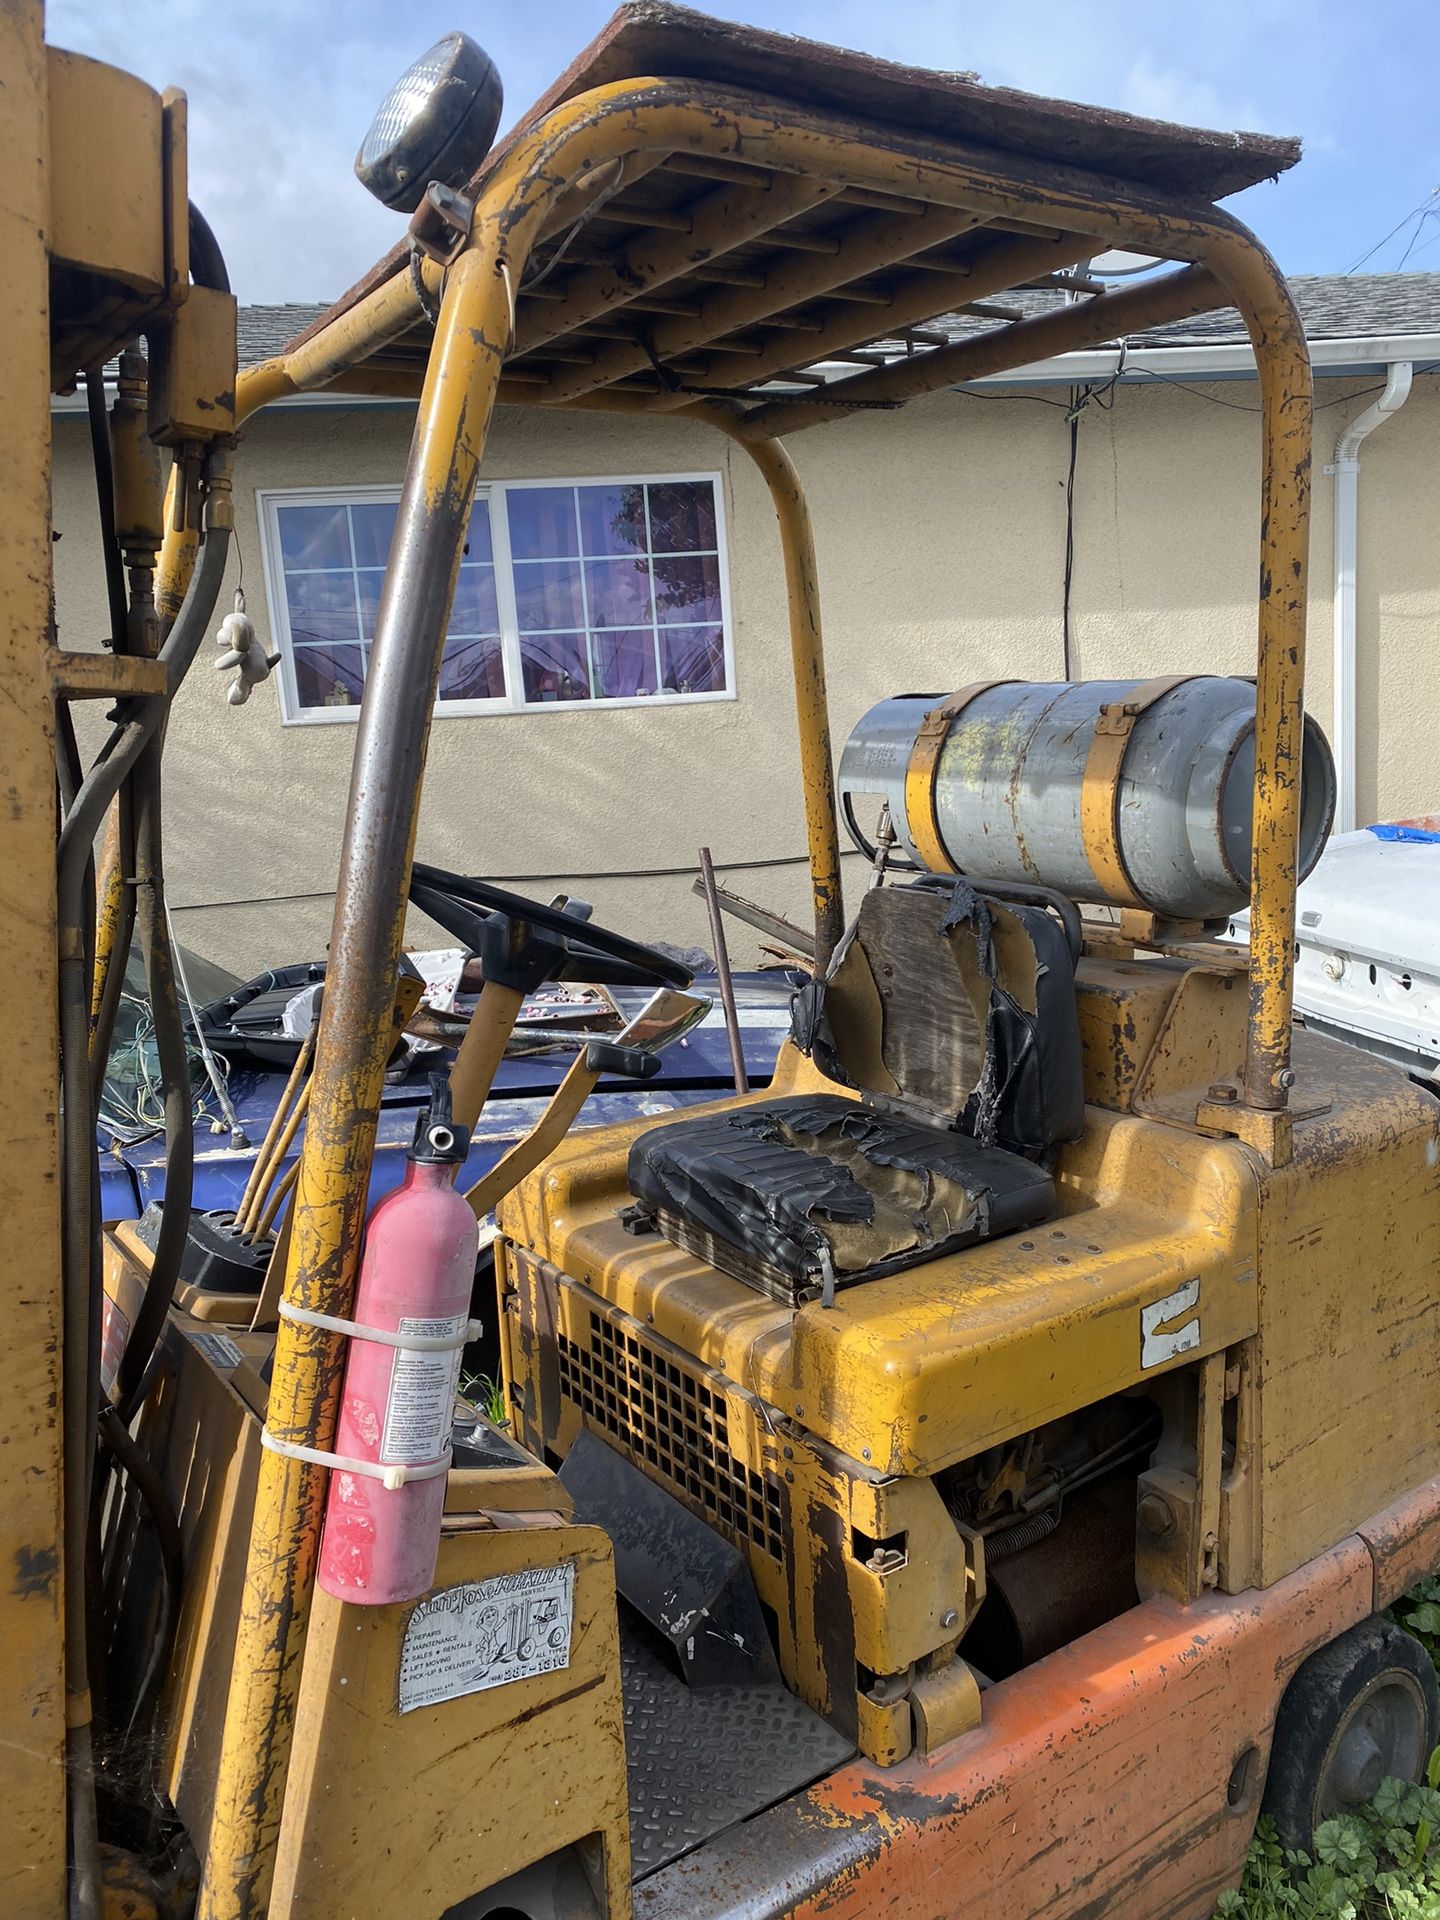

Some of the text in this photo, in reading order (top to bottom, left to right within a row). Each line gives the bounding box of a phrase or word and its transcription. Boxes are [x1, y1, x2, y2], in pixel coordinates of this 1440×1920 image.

[494, 1566, 568, 1595] FORKLIFT
[521, 1586, 547, 1596] SERVICE
[412, 1634, 458, 1651] MAINTENANCE
[414, 1630, 441, 1640] REPAIRS
[412, 1640, 473, 1661] SALES RENTALS
[549, 1646, 567, 1655] TYPES
[410, 1655, 452, 1672] LIFT MOVING
[444, 1659, 476, 1672] DELIVERY
